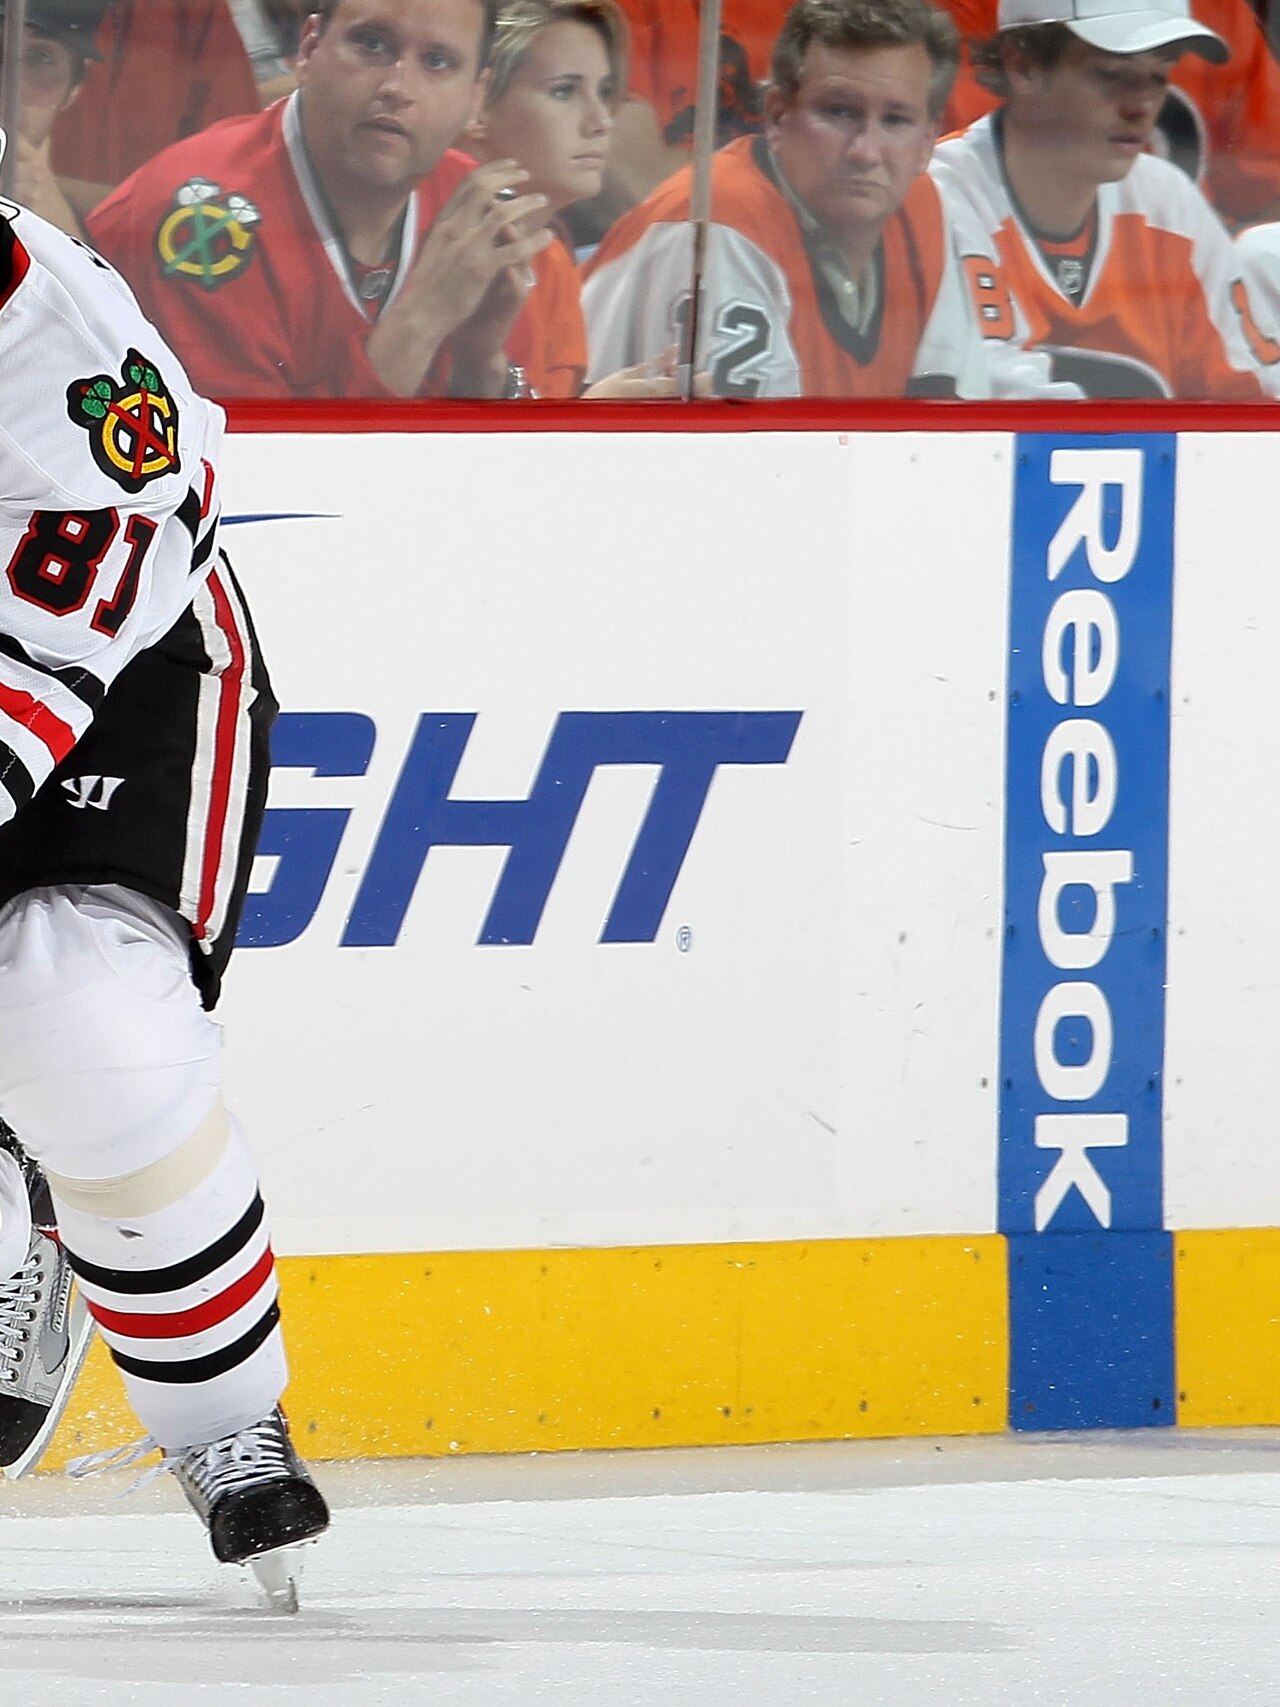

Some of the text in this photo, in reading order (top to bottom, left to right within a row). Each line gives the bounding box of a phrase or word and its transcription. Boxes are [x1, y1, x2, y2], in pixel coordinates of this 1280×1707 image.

[5, 506, 158, 638] 81
[227, 709, 805, 948] GHT
[1032, 446, 1146, 1233] Reebok
